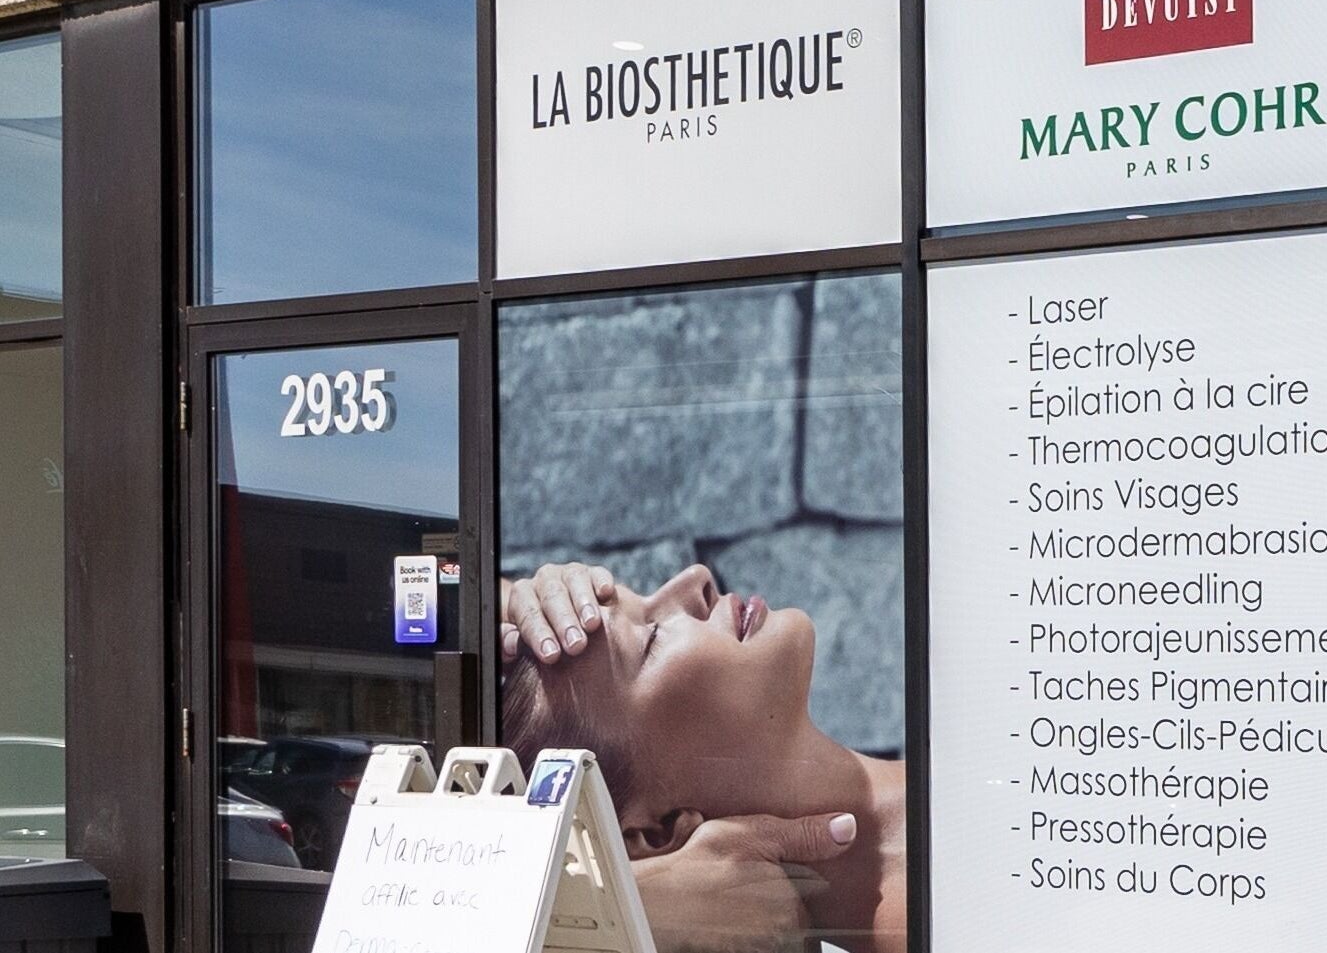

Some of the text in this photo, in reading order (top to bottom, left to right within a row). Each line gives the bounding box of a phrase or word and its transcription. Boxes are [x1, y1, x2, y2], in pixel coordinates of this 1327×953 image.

[532, 70, 571, 130] LA
[646, 114, 718, 144] PARIS
[1020, 82, 1327, 160] MARY COHR
[1126, 154, 1211, 179] PARIS
[1028, 295, 1109, 325] Laser
[1028, 334, 1196, 372] Électrolyse
[280, 368, 388, 437] 2935
[1028, 382, 1162, 425] Épilation
[1173, 378, 1194, 411] à
[1206, 378, 1235, 409] la
[1246, 374, 1310, 407] cire
[1028, 480, 1104, 513] Soins
[1115, 478, 1240, 515] Visages
[1029, 573, 1263, 612] Microneedling
[1029, 670, 1140, 702] Taches
[1030, 766, 1270, 807] Massothérapie
[365, 822, 507, 866] Maintenant
[1030, 811, 1268, 856] Pressothérapie
[1030, 858, 1106, 892] Soins
[1116, 861, 1157, 894] du
[1169, 864, 1267, 905] Corps
